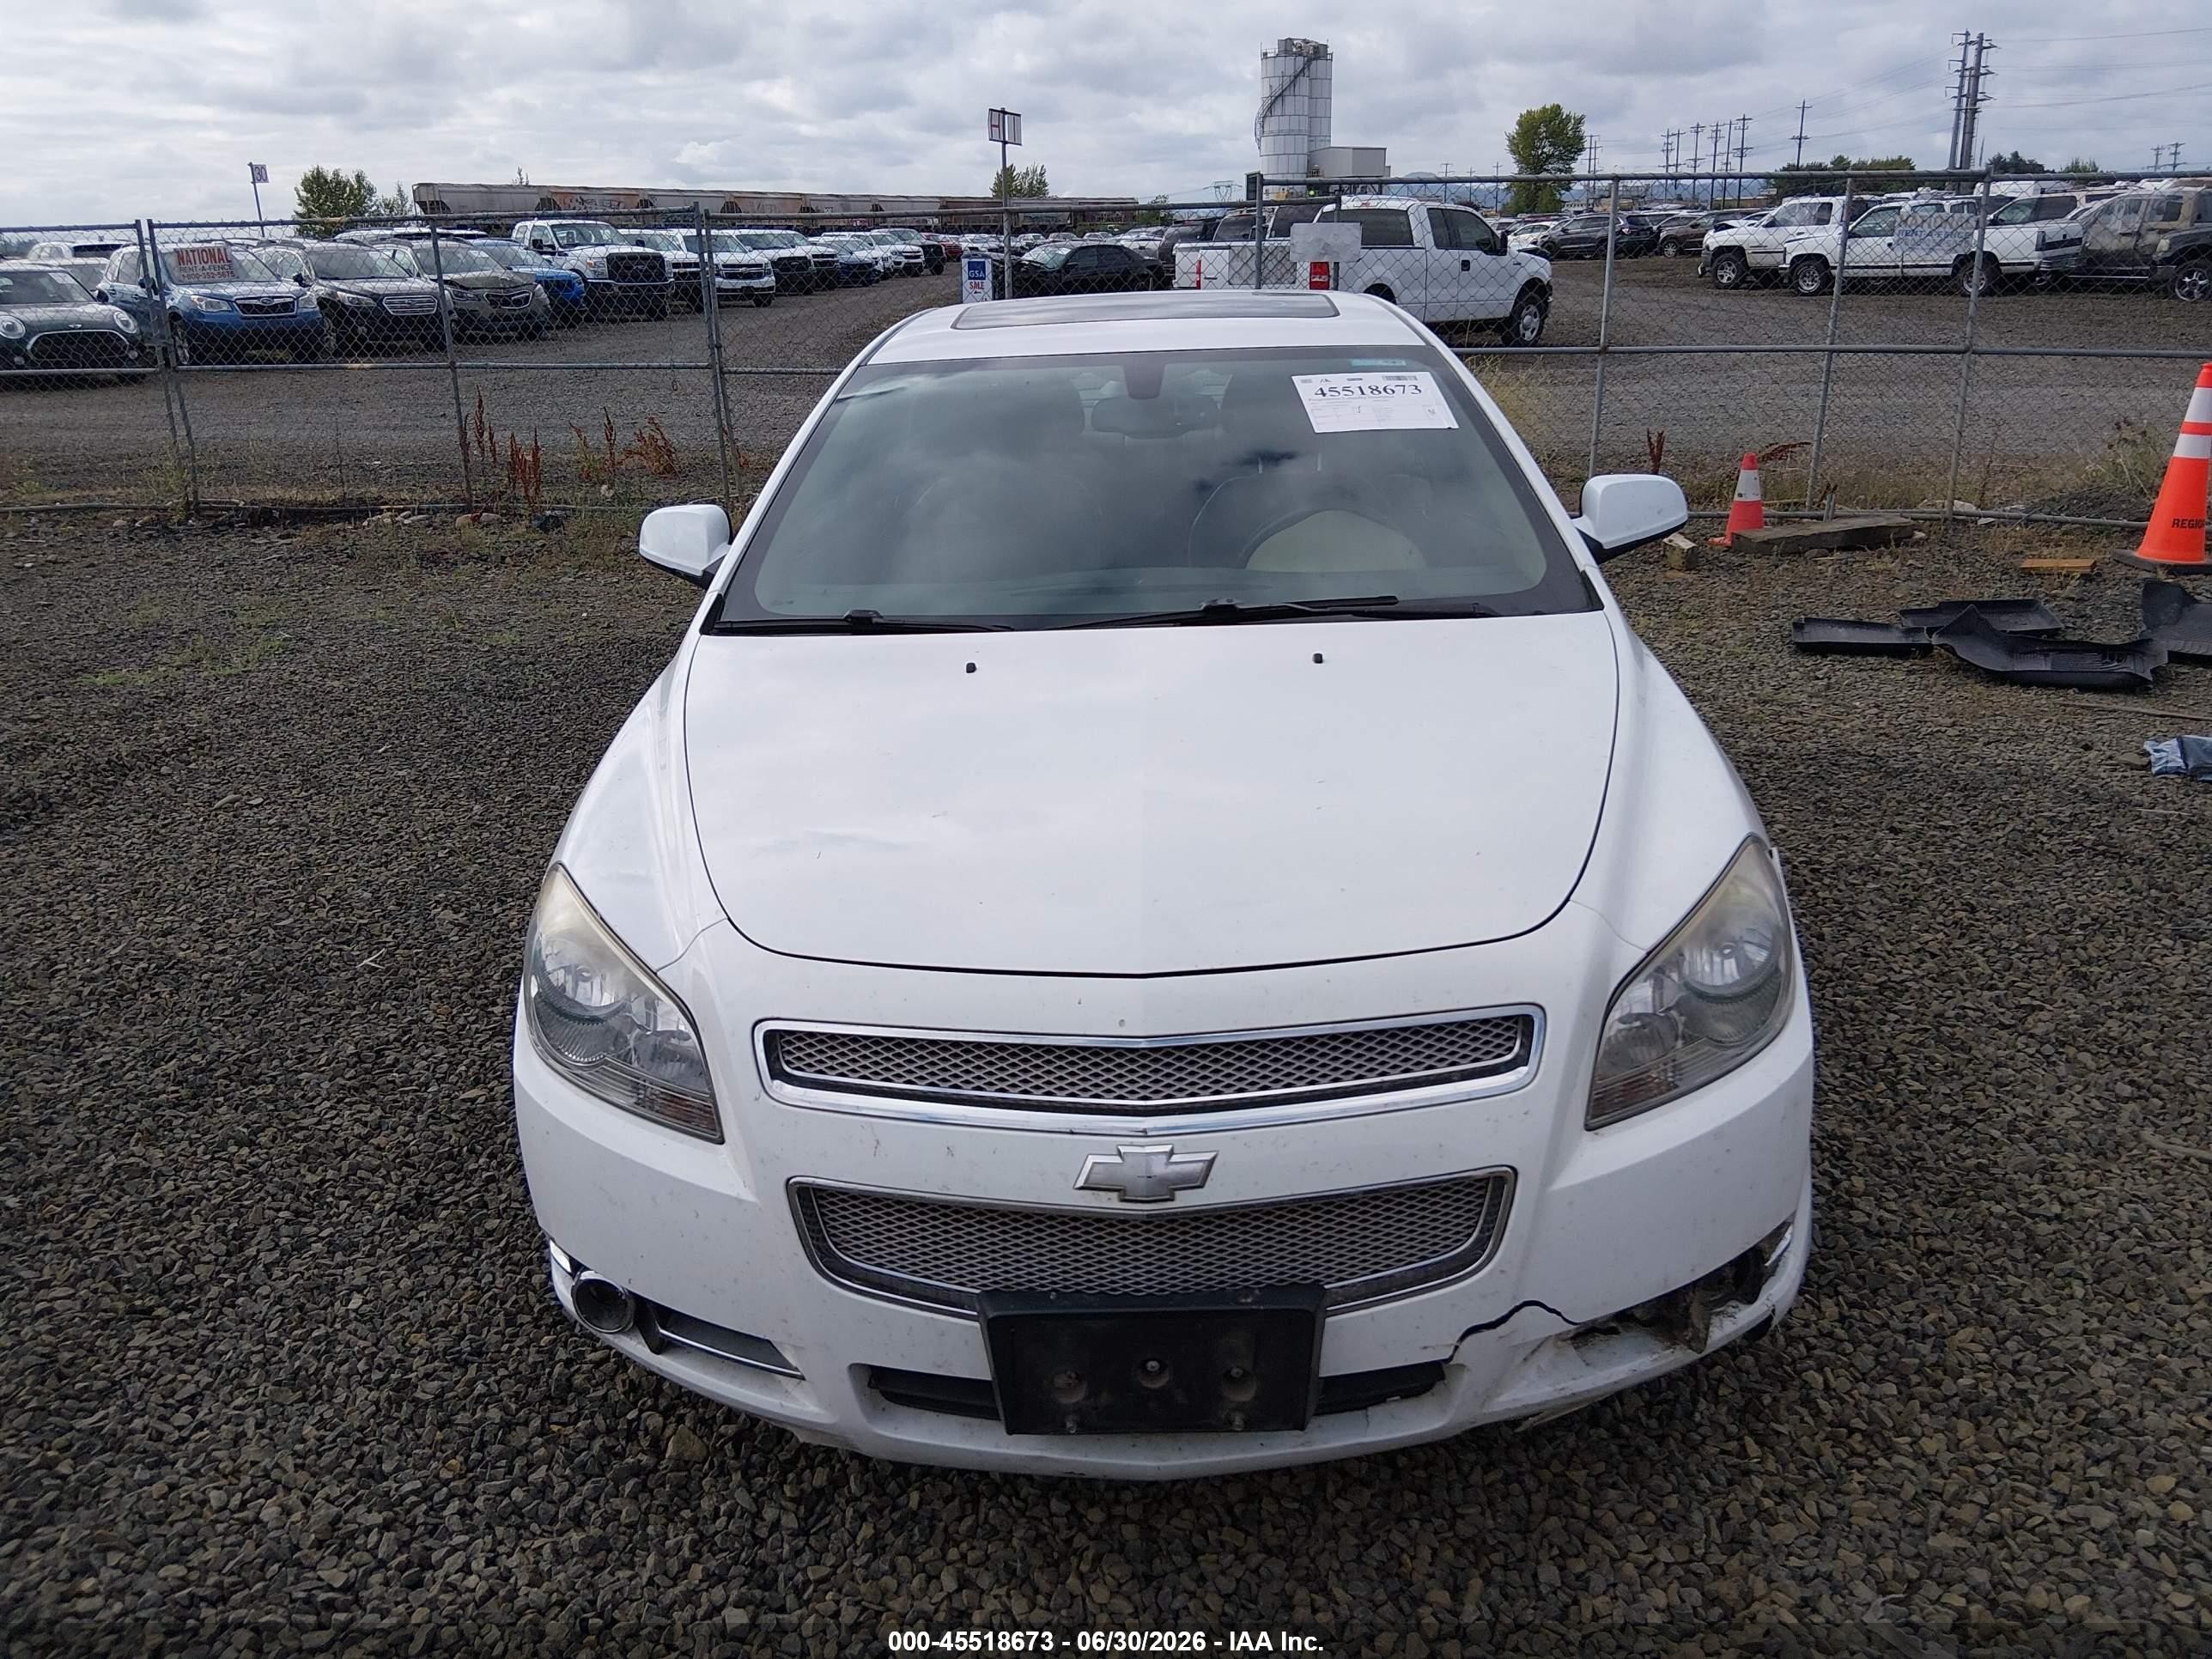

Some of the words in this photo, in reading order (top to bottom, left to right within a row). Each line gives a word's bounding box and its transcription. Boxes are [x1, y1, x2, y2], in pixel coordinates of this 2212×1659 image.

[254, 166, 268, 182] 30
[176, 247, 233, 266] NATIONAL
[179, 264, 234, 273] RENT-A-FENCE
[969, 270, 986, 279] GSA
[969, 281, 985, 290] SALE
[1314, 384, 1422, 398] 45518673
